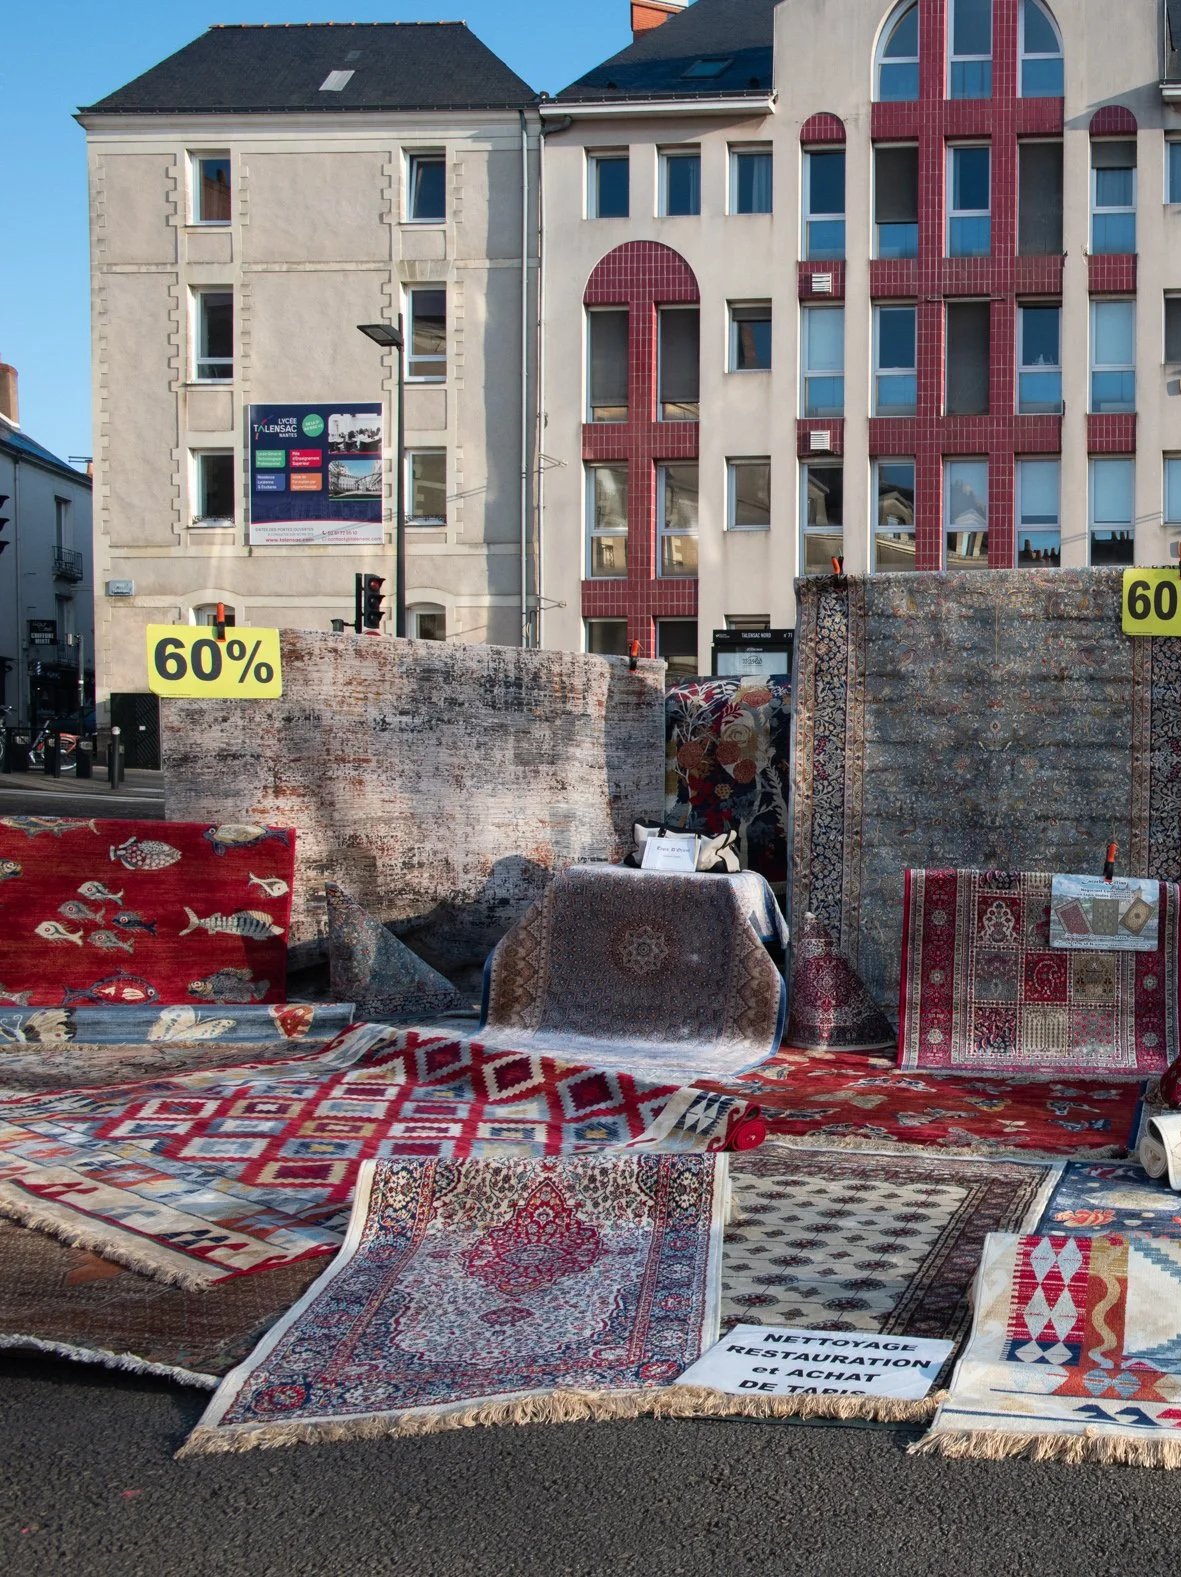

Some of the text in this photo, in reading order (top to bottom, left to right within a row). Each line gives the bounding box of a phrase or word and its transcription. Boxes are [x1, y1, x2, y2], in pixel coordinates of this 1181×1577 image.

[253, 424, 298, 433] TALENSAC
[154, 637, 274, 684] 60%
[763, 1333, 918, 1352] NETTOYAGE
[726, 1344, 932, 1369] RESTAURATION
[752, 1366, 881, 1382] et ACHAT
[738, 1379, 778, 1392] DE
